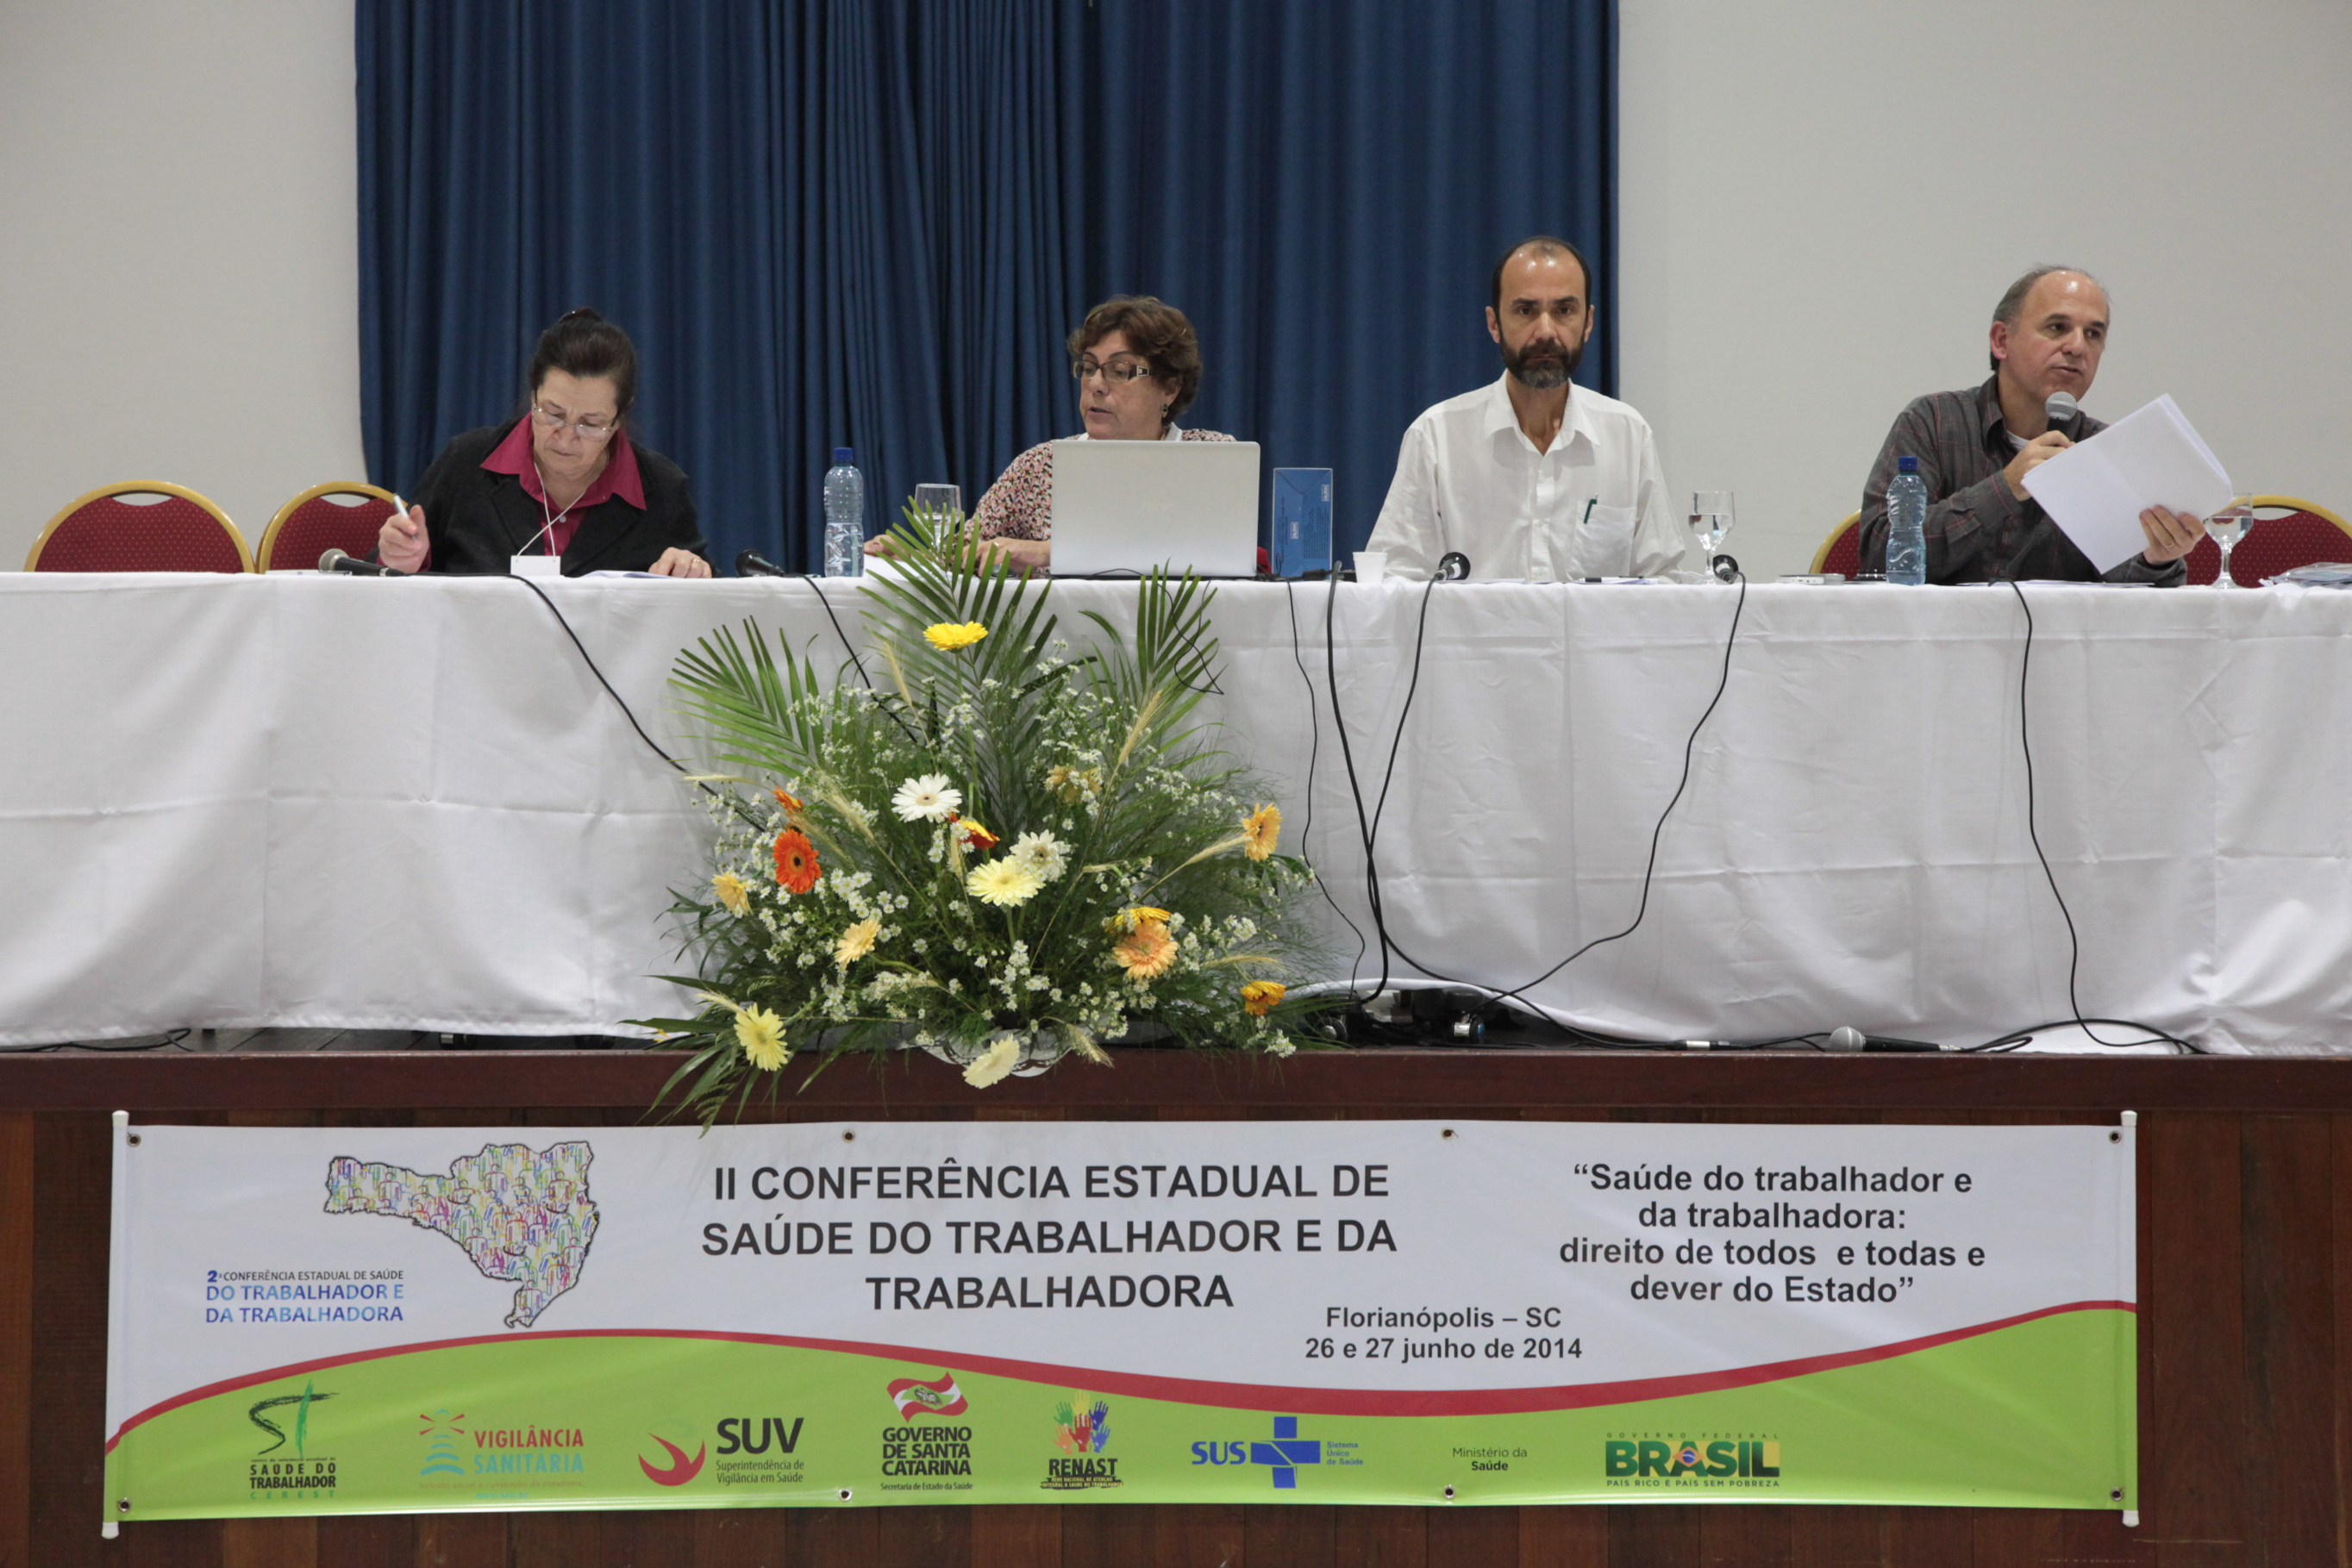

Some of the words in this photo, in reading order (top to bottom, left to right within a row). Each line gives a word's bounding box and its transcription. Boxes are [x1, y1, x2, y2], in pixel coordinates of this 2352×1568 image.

[716, 1167, 735, 1200] II
[751, 1157, 1071, 1201] CONFERÊNCIA
[1085, 1165, 1318, 1198] ESTADUAL
[1333, 1165, 1389, 1197] DE
[1704, 1165, 1744, 1191] do
[1754, 1165, 1945, 1193] trabalhador
[1954, 1172, 1973, 1193] e
[1638, 1201, 1676, 1228] da
[1687, 1202, 1905, 1229] trabalhadora:
[702, 1213, 854, 1256] SAÚDE
[869, 1221, 931, 1255] DO
[945, 1219, 1282, 1254] TRABALHADOR
[1297, 1219, 1322, 1253] E
[1337, 1219, 1398, 1252] DA
[1560, 1237, 1664, 1265] direito
[1675, 1238, 1713, 1265] de
[1723, 1239, 1817, 1265] todos
[1836, 1246, 1855, 1266] e
[1865, 1240, 1956, 1266] todas
[1967, 1246, 1986, 1267] e
[223, 1270, 296, 1281] CONFERÊNCIA
[298, 1271, 351, 1280] ESTADUAL
[353, 1271, 367, 1280] DE
[370, 1268, 404, 1279] SAÚDE
[206, 1285, 235, 1301] DO
[241, 1284, 387, 1300] TRABALHADOR
[394, 1284, 403, 1299] E
[865, 1274, 1235, 1310] TRABALHADORA
[1630, 1274, 1723, 1301] dever
[1733, 1275, 1773, 1303] do
[1785, 1276, 1913, 1303] Estado”
[206, 1308, 234, 1323] DA
[240, 1306, 403, 1323] TRABALHADORA
[1327, 1306, 1494, 1333] Florianópolis
[1525, 1307, 1561, 1328] SC
[1305, 1337, 1335, 1359] 26
[1342, 1342, 1357, 1359] e
[1365, 1337, 1395, 1359] 27
[1401, 1337, 1476, 1365] junho
[1484, 1337, 1515, 1359] de
[1523, 1337, 1582, 1359] 2014
[474, 1425, 584, 1448] VIGILÂNCIA
[716, 1417, 804, 1455] SUV
[882, 1427, 973, 1442] GOVERNO
[474, 1448, 584, 1474] SANITÁRIA
[883, 1443, 907, 1459] DE
[911, 1443, 971, 1459] SANTA
[1192, 1441, 1246, 1465] SUS
[1453, 1447, 1509, 1458] Ministério
[1512, 1447, 1527, 1458] da
[1605, 1440, 1780, 1477] BRASIL
[316, 1463, 336, 1474] DO
[716, 1459, 791, 1472] Superintendência
[793, 1459, 804, 1470] de
[881, 1459, 972, 1476] CATARINA
[1048, 1459, 1118, 1477] RENAST
[1472, 1460, 1508, 1471] Saúde
[250, 1476, 336, 1489] TRABALHADOR
[716, 1472, 759, 1486] Vigilância
[760, 1474, 774, 1483] em
[776, 1471, 804, 1483] Saúde
[250, 1490, 335, 1499] CEREST
